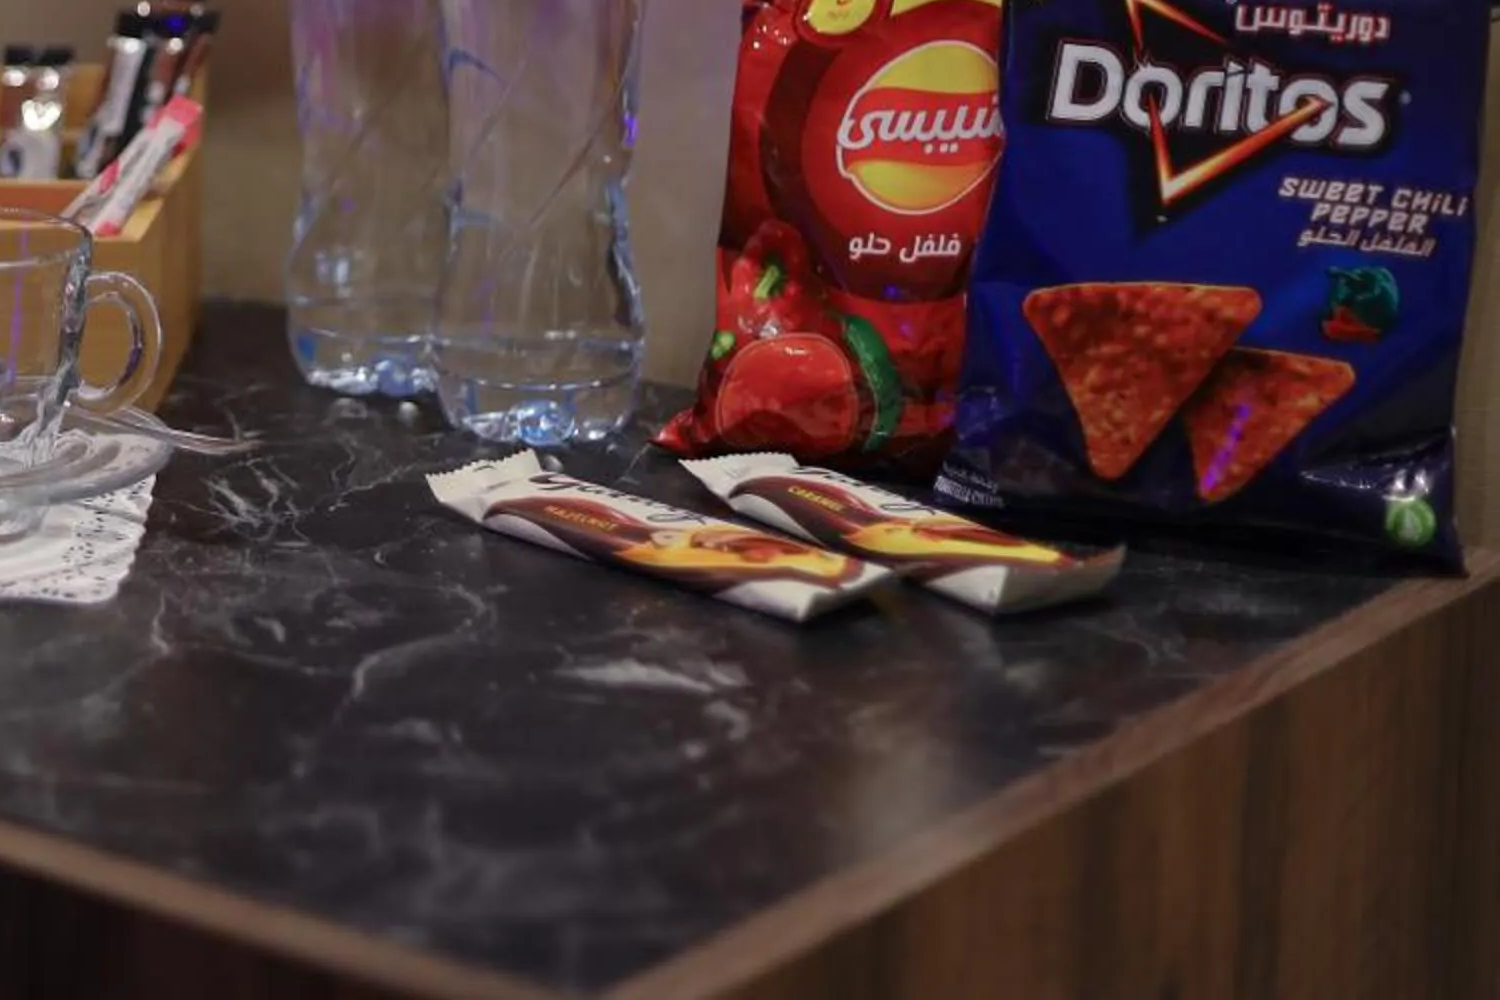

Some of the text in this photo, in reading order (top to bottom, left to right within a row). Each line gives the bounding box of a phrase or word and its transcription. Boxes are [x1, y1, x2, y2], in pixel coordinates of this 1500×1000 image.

[1235, 2, 1391, 42] دوريتوس
[1049, 42, 1390, 146] Doritos
[1279, 176, 1384, 204] SWEET
[1311, 202, 1429, 235] PEPPER
[849, 232, 961, 263] فلفل حلو
